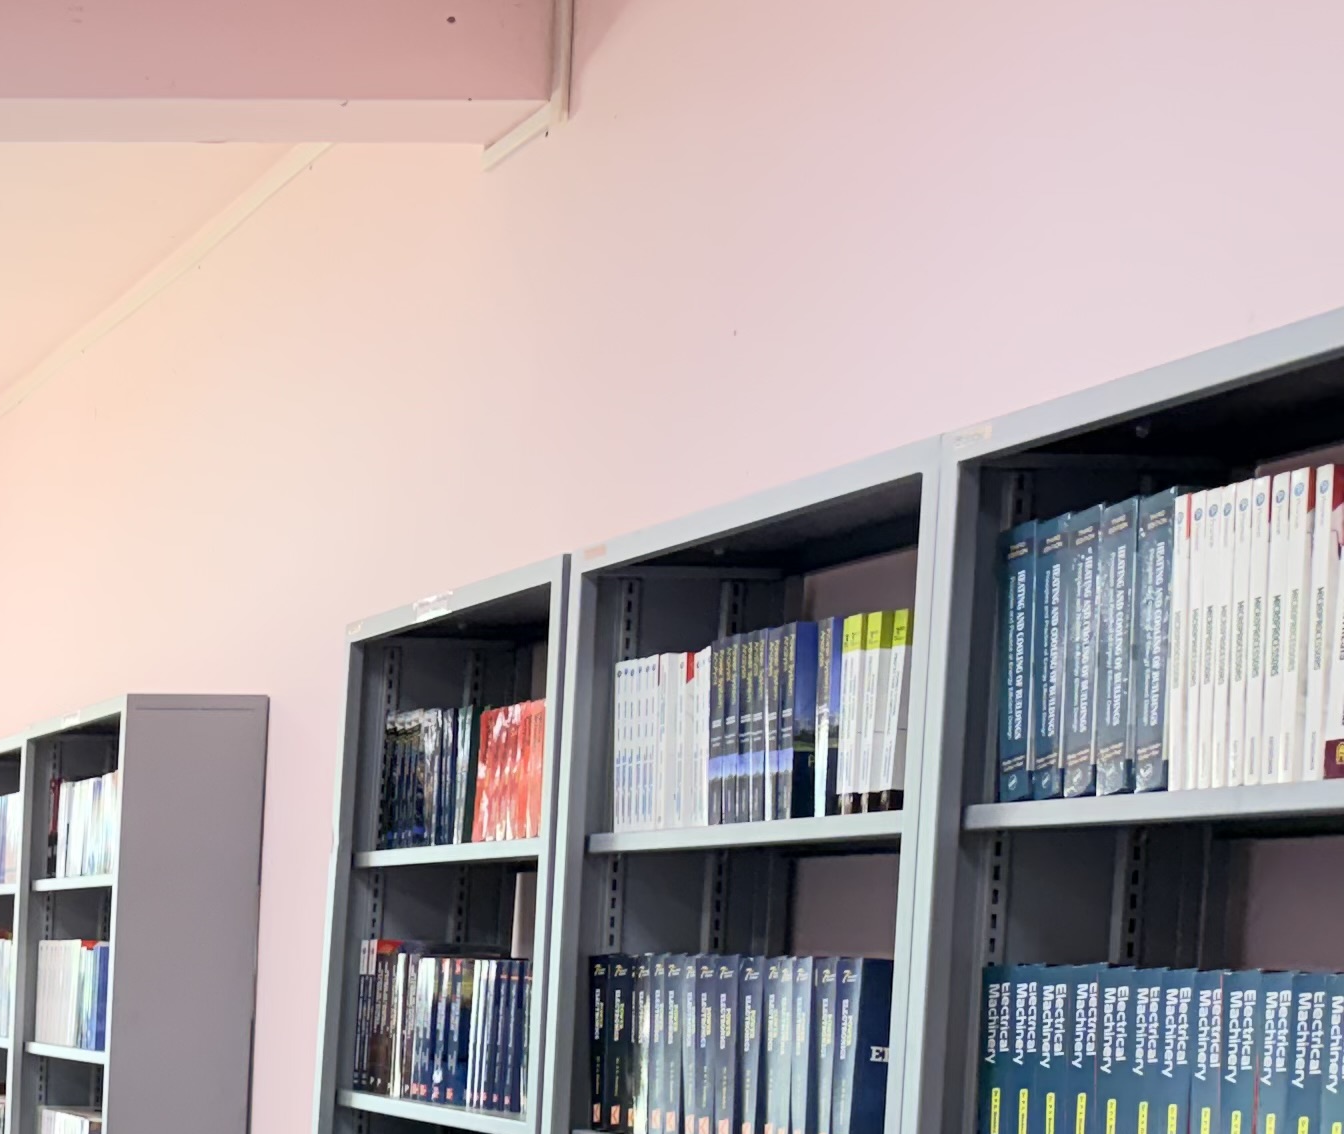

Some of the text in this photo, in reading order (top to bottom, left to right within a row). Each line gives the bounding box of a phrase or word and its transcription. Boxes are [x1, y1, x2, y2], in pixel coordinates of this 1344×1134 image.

[1017, 570, 1026, 610] HEATING
[1052, 564, 1061, 605] HEATING
[1116, 590, 1124, 610] AND
[1117, 545, 1126, 588] HEATING
[1154, 588, 1163, 607] AND
[1155, 542, 1165, 585] HEATING
[1016, 612, 1025, 631] AND
[1016, 632, 1025, 673] COOLING
[1050, 627, 1059, 669] COOLING
[1051, 606, 1060, 626] AND
[1114, 612, 1124, 655] COOLING
[1153, 610, 1162, 654] COOLING
[1014, 689, 1023, 740] BUILDINGS
[1048, 685, 1057, 736] BUILDINGS
[1113, 673, 1122, 726] BUILDINGS
[1150, 671, 1159, 726] BUILDINGS
[985, 984, 1000, 1064] Machinery
[1000, 982, 1011, 1052] Electrical
[1013, 983, 1028, 1065] Machinery
[1027, 982, 1037, 1053] Electrical
[1040, 985, 1055, 1068] Machinery
[1054, 983, 1067, 1056] Electrical
[1072, 983, 1088, 1069] Machinery
[1086, 982, 1097, 1056] Electrical
[1100, 987, 1117, 1074] Machinery
[1115, 985, 1129, 1062] Electrical
[1132, 988, 1149, 1076] Machinery
[1147, 986, 1160, 1063] Electrical
[1161, 988, 1178, 1078] Machinery
[1176, 987, 1192, 1065] Electrical
[1194, 990, 1211, 1081] Machinery
[1210, 988, 1222, 1068] Electrical
[1224, 991, 1243, 1084] Machinery
[1240, 989, 1257, 1070] Electrical
[1260, 991, 1279, 1086] Machinery
[1275, 990, 1292, 1073] Electrical
[1292, 993, 1312, 1089] Machinery
[1309, 991, 1325, 1075] Electrical
[1325, 995, 1344, 1094] Machinery
